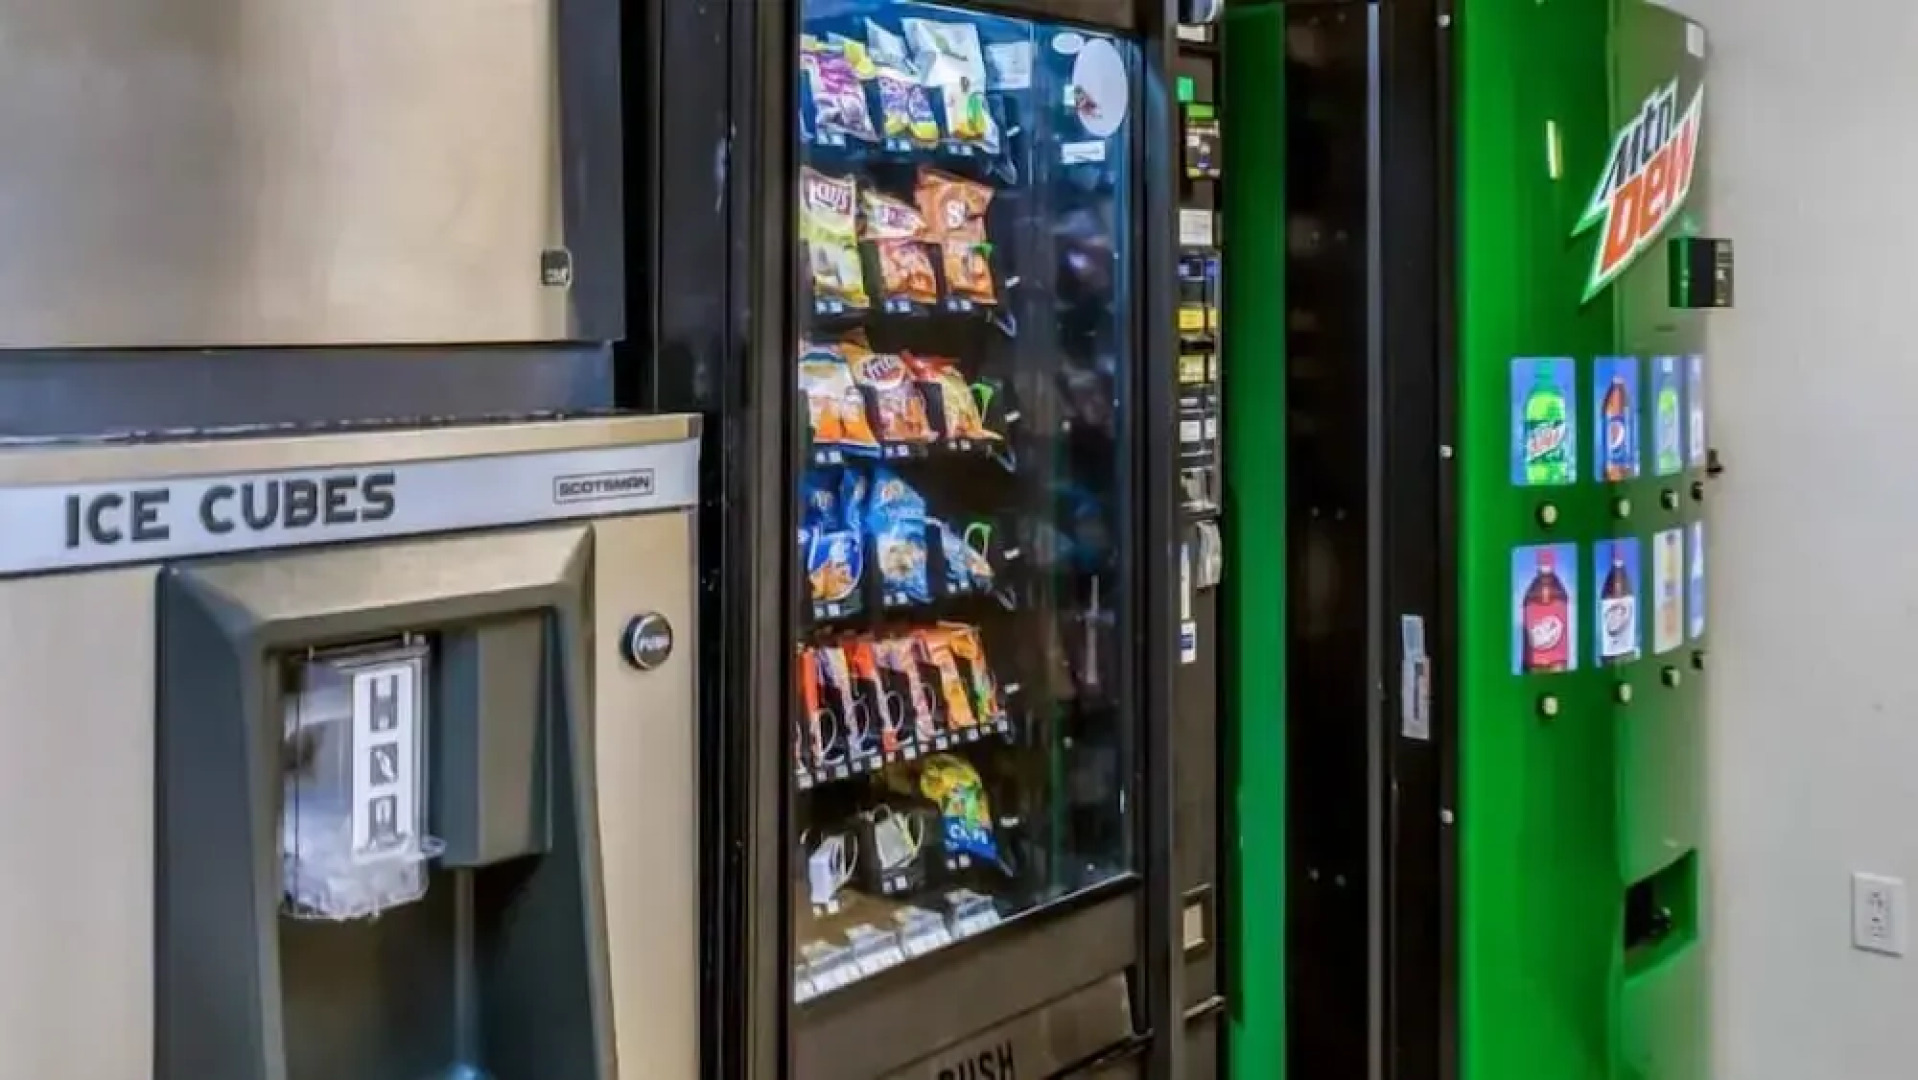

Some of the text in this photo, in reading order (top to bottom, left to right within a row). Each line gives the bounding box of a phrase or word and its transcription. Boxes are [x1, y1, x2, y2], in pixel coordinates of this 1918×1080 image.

[65, 470, 396, 549] ICE CUBES
[559, 476, 649, 497] SCOTSMAN
